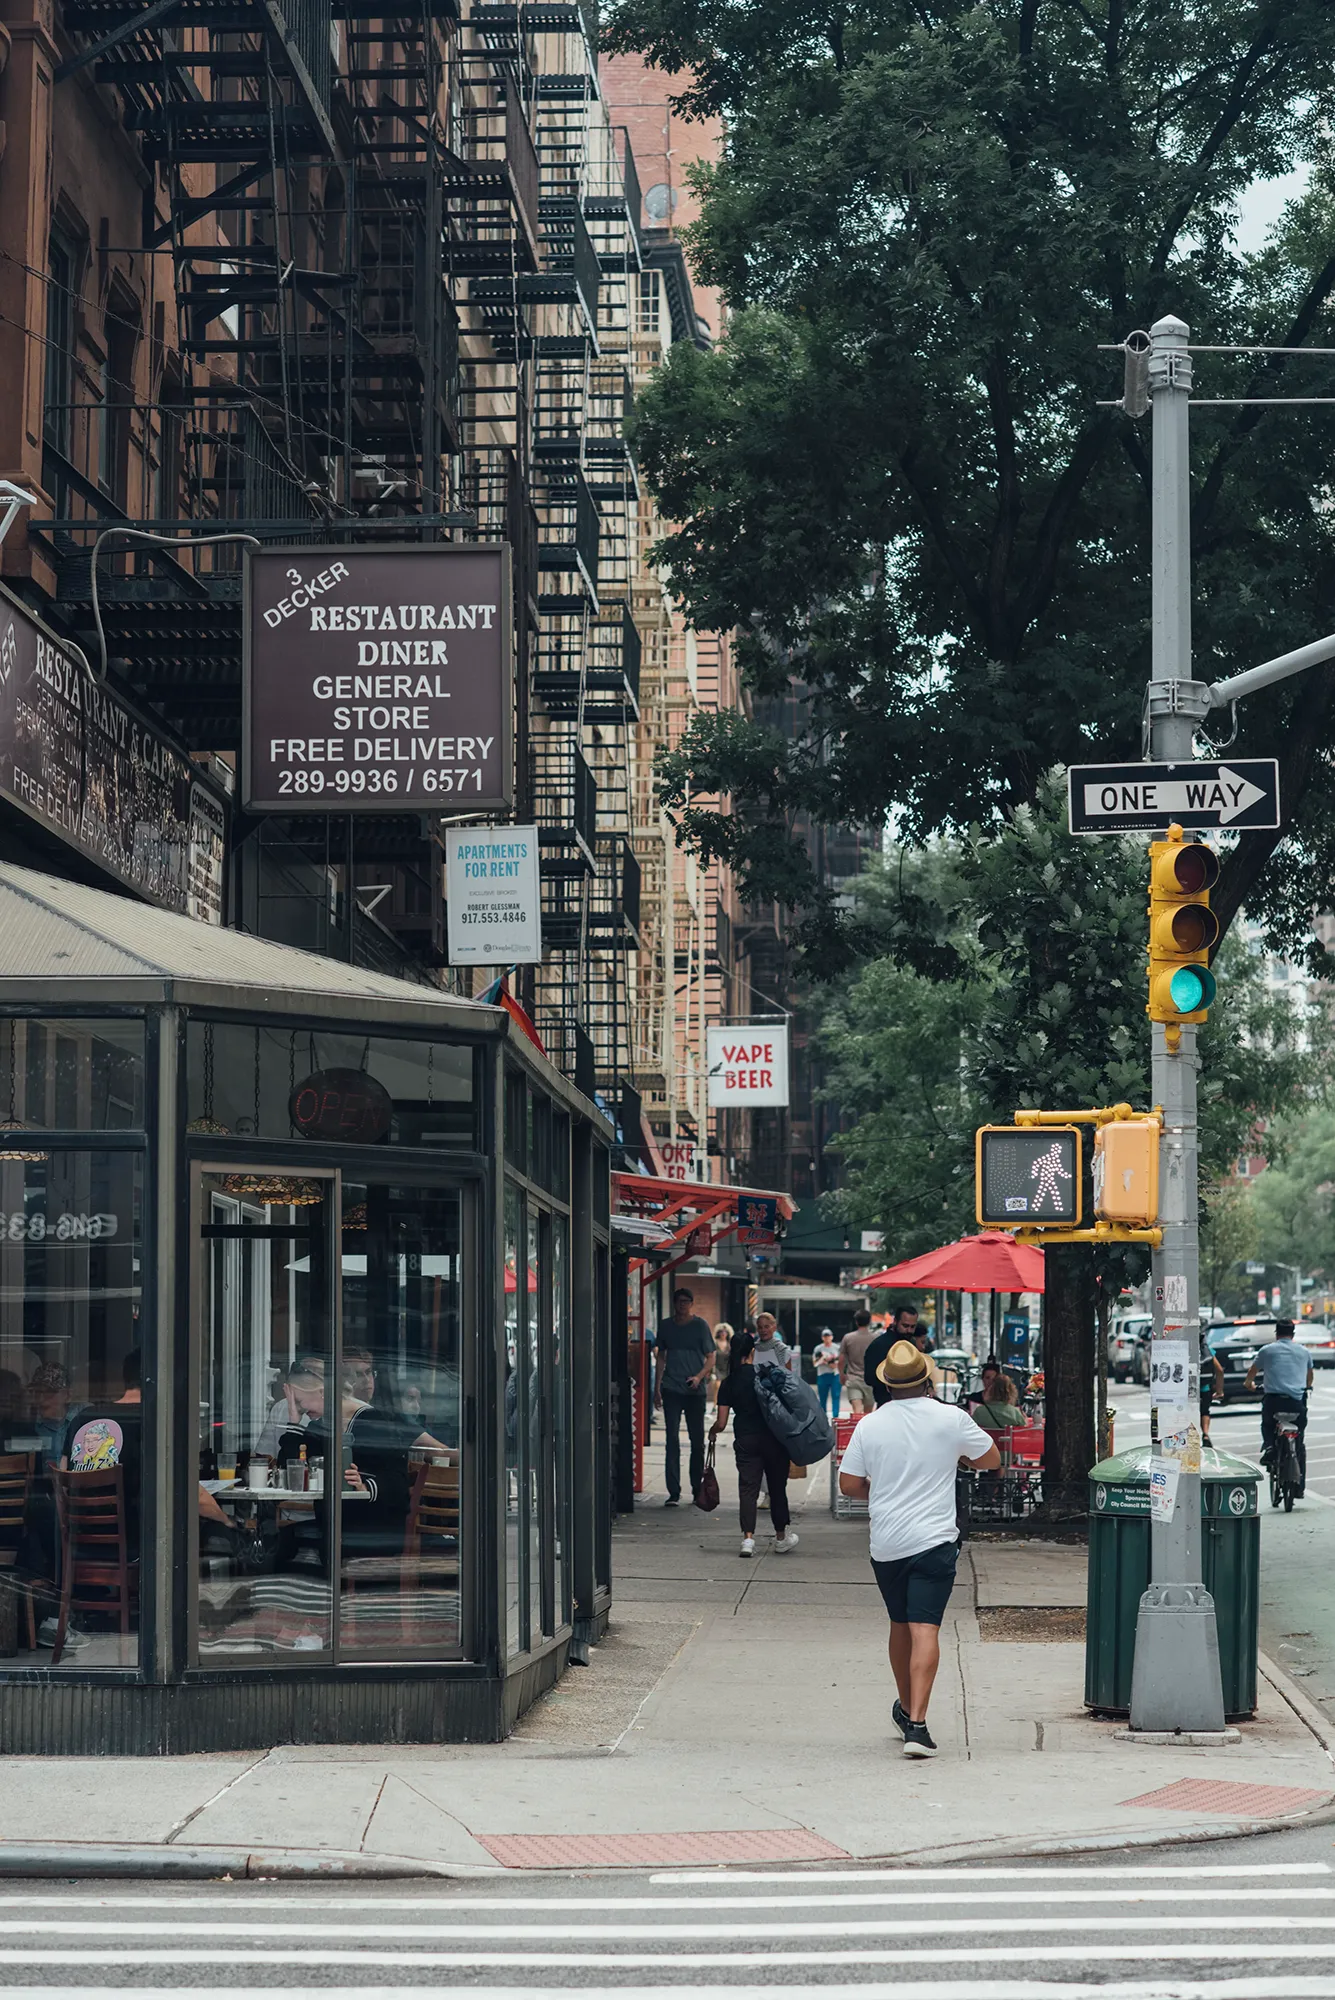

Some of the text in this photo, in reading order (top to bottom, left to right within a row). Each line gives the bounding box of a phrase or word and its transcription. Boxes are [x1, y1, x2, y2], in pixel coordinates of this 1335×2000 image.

[286, 568, 302, 586] 3
[263, 561, 350, 628] DECKER
[310, 604, 496, 631] RESTAURANT
[358, 640, 448, 666] DINER
[35, 632, 128, 749] RESTAURANT
[130, 722, 140, 763] &
[312, 675, 450, 699] GENERAL
[333, 706, 430, 730] STORE
[269, 737, 494, 762] FREE DELIVERY
[278, 768, 482, 793] 289-9936 / 6571
[1101, 783, 1245, 812] ONE WAY
[14, 766, 44, 811] FREE
[47, 791, 101, 851] DELIVERY
[102, 832, 142, 884] 289-9936
[457, 844, 528, 860] APARTMENTS
[465, 861, 520, 878] FOR RENT
[461, 912, 526, 924] 917.553.4846
[722, 1044, 773, 1064] VAPE
[725, 1069, 773, 1089] BEER
[296, 1088, 381, 1129] OPEN
[661, 1142, 694, 1164] OKE
[1014, 1327, 1024, 1342] P
[1110, 1486, 1123, 1494] Keep
[1110, 1500, 1120, 1508] City
